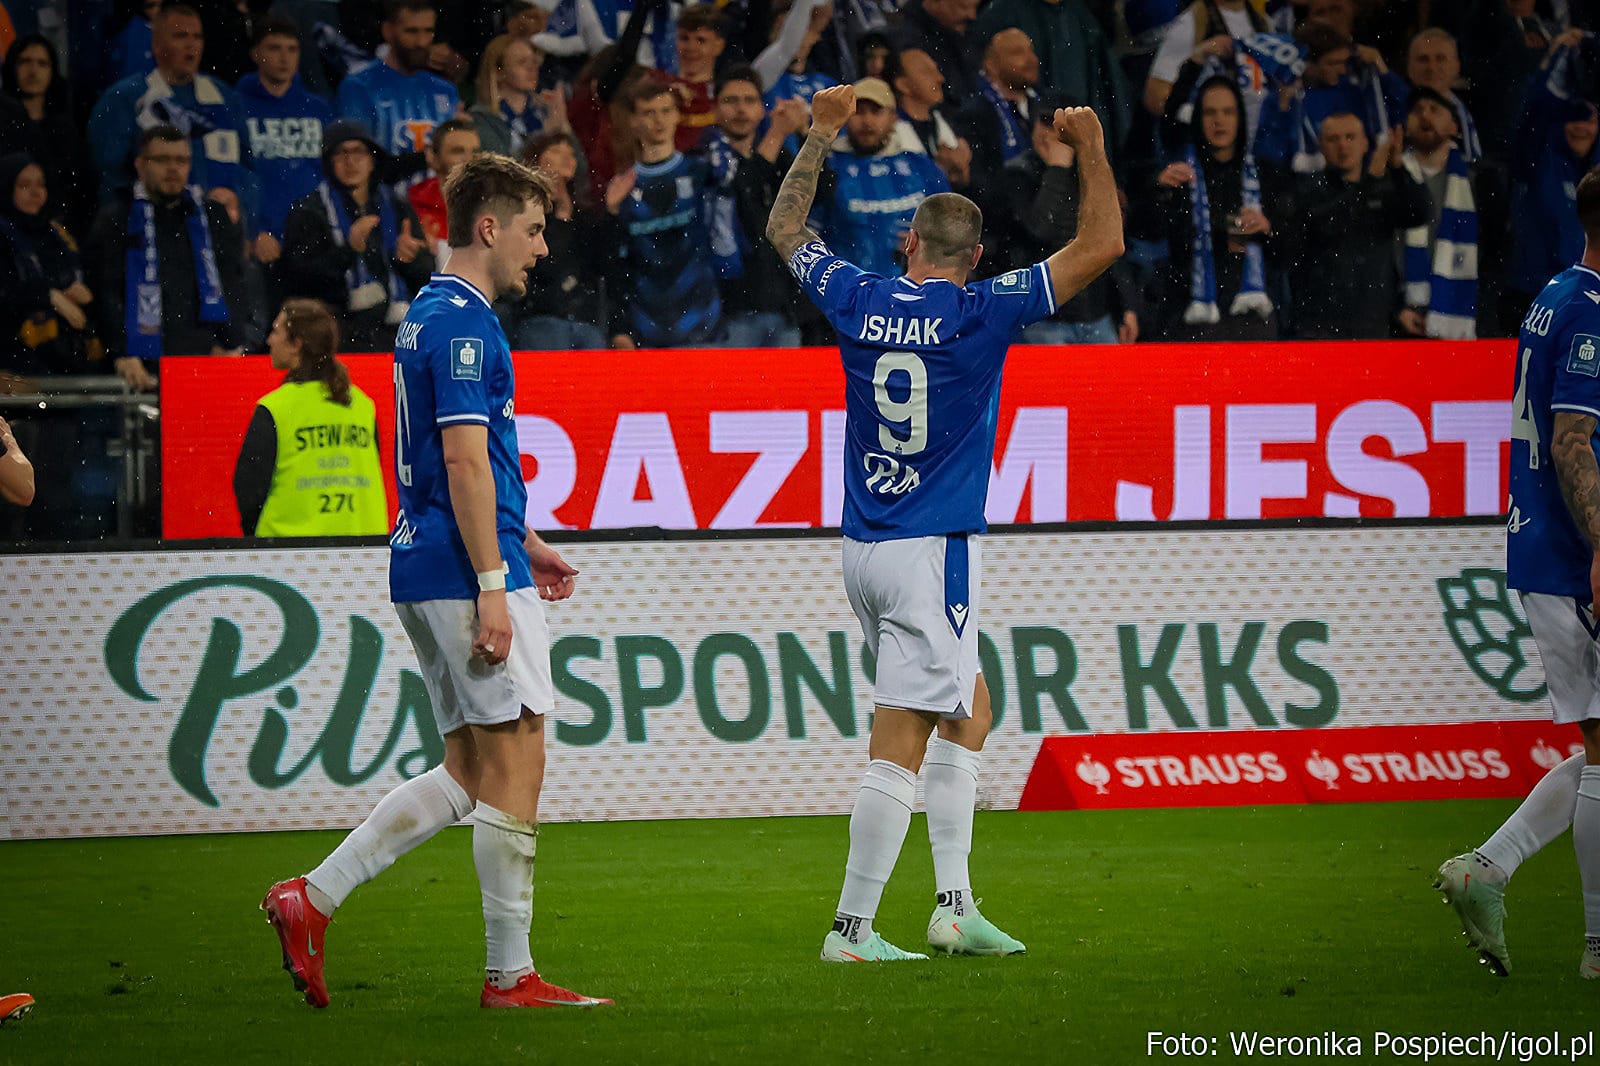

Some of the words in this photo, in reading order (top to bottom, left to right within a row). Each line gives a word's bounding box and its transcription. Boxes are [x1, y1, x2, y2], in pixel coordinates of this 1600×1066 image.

[246, 117, 322, 141] LECH
[815, 259, 848, 296] Ebury
[859, 315, 943, 345] ISHAK
[872, 352, 928, 455] 9
[295, 424, 371, 452] STEWARD
[864, 452, 920, 494] Pils
[104, 574, 446, 808] Pils
[1116, 620, 1340, 730] KKS
[1115, 752, 1288, 787] STRAUSS
[1342, 747, 1511, 782] STRAUSS
